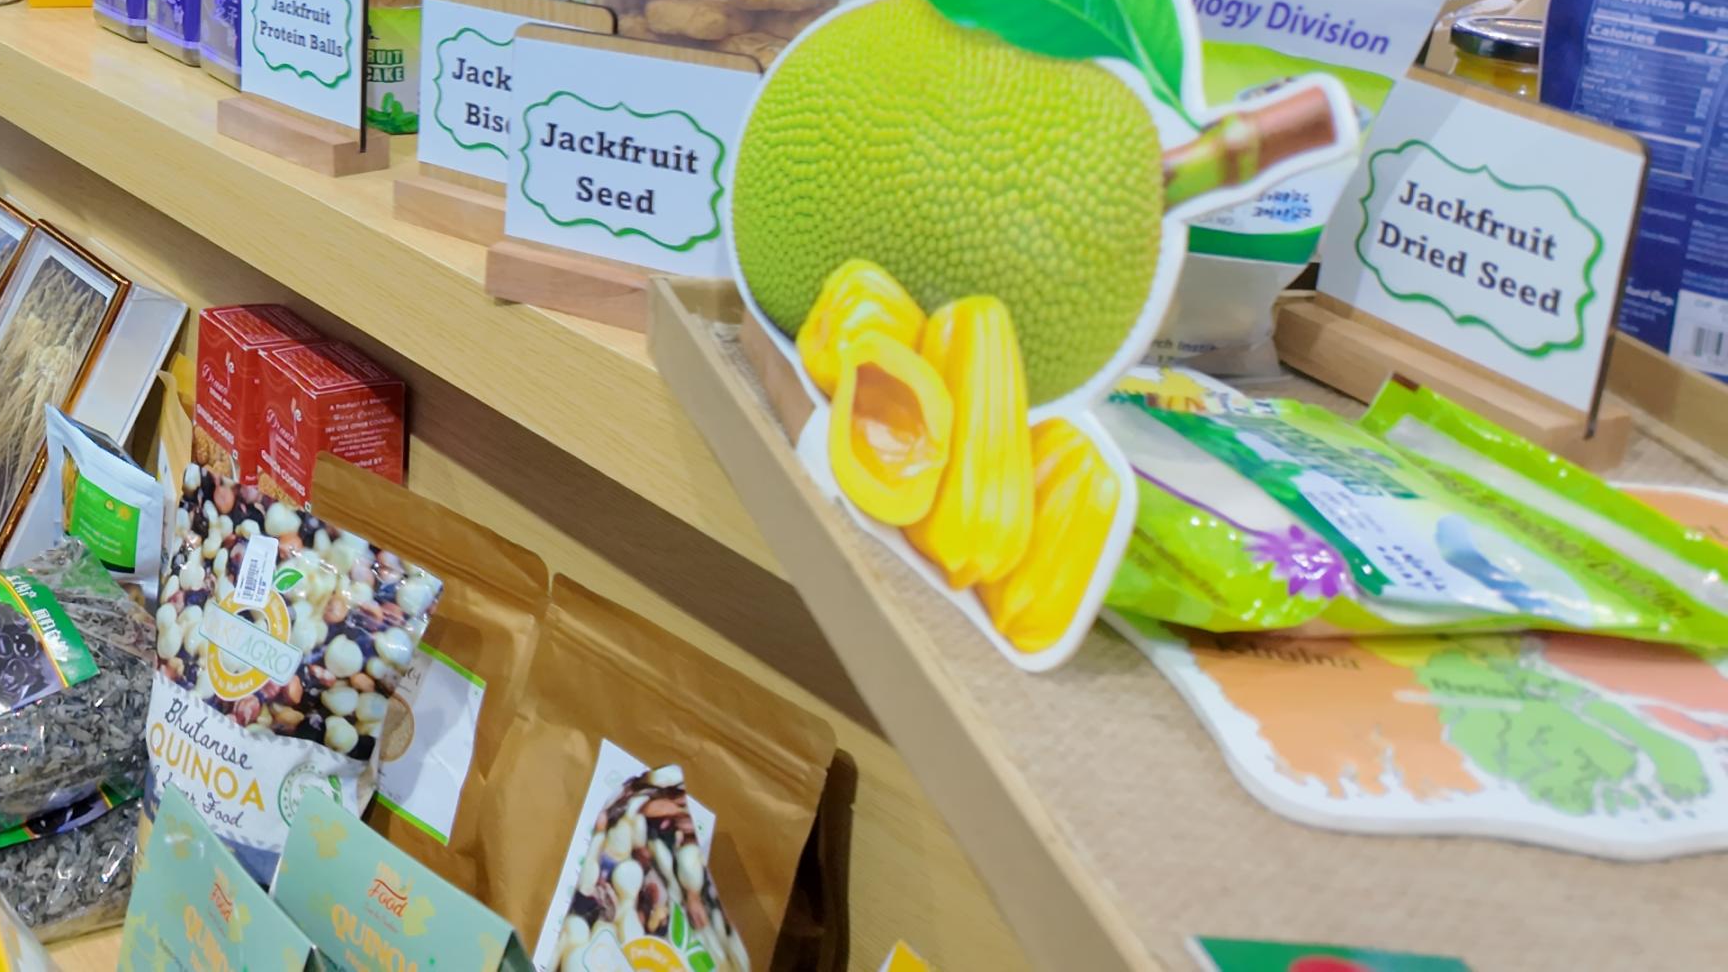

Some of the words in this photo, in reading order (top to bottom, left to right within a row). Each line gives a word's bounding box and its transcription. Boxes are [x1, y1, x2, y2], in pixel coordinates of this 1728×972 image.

[259, 19, 306, 48] Protein
[310, 36, 344, 59] Balls
[1266, 0, 1391, 55] Division
[1590, 24, 1657, 46] Calories
[367, 49, 403, 65] RUIT
[452, 57, 512, 92] Jack
[540, 122, 699, 175] Jackfruit
[576, 176, 656, 216] Seed
[1398, 180, 1557, 261] Jackfruit
[1377, 220, 1468, 278] Dried
[1477, 260, 1562, 316] Seed
[164, 697, 253, 771] Bhutanese
[148, 722, 266, 813] QUINOA
[204, 792, 243, 829] Food
[368, 878, 409, 918] Food
